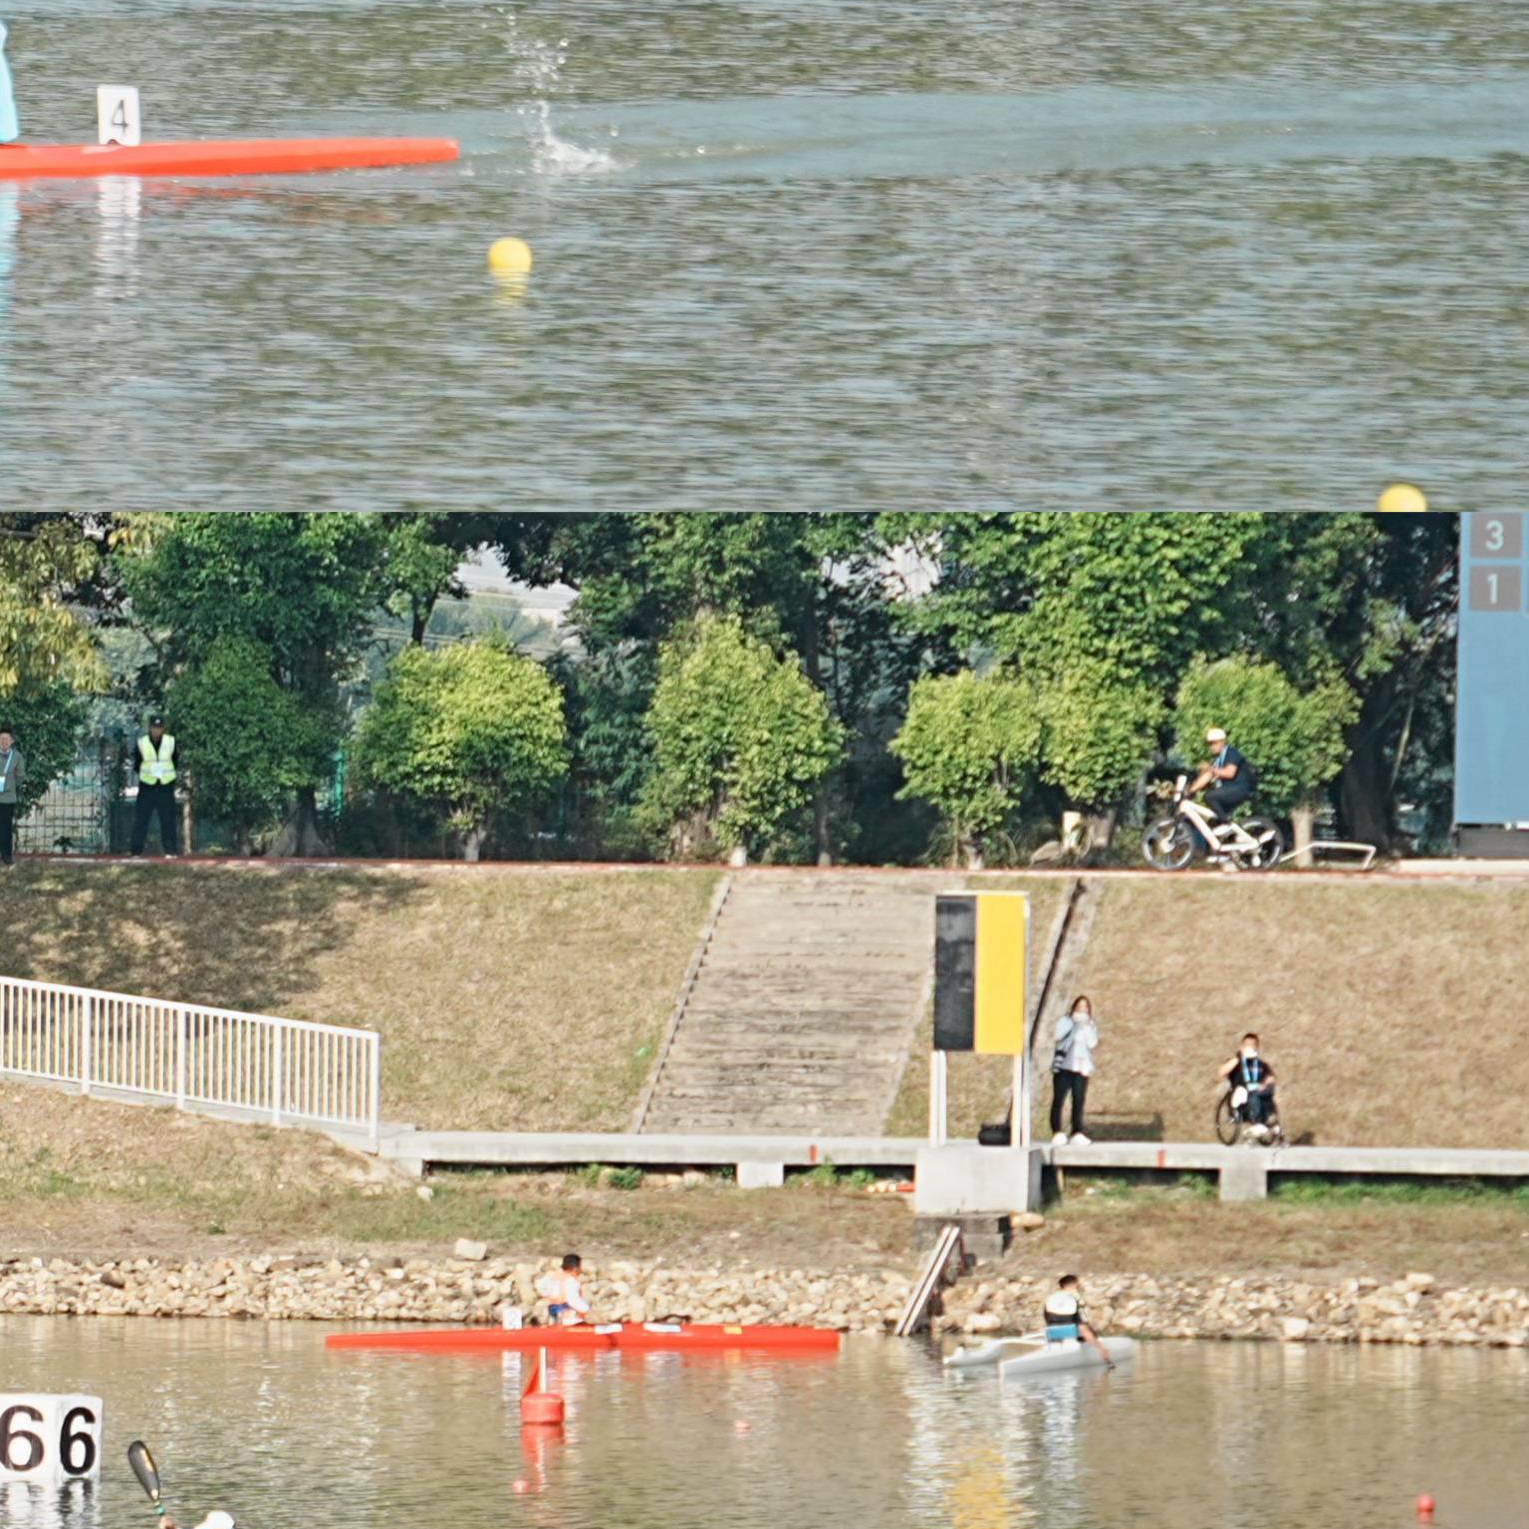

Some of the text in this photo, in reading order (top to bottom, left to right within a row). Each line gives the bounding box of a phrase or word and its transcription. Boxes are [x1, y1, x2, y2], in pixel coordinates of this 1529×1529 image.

[111, 99, 129, 136] 4
[1485, 519, 1504, 551] 3
[1487, 573, 1498, 604] 1
[60, 1407, 96, 1475] 6
